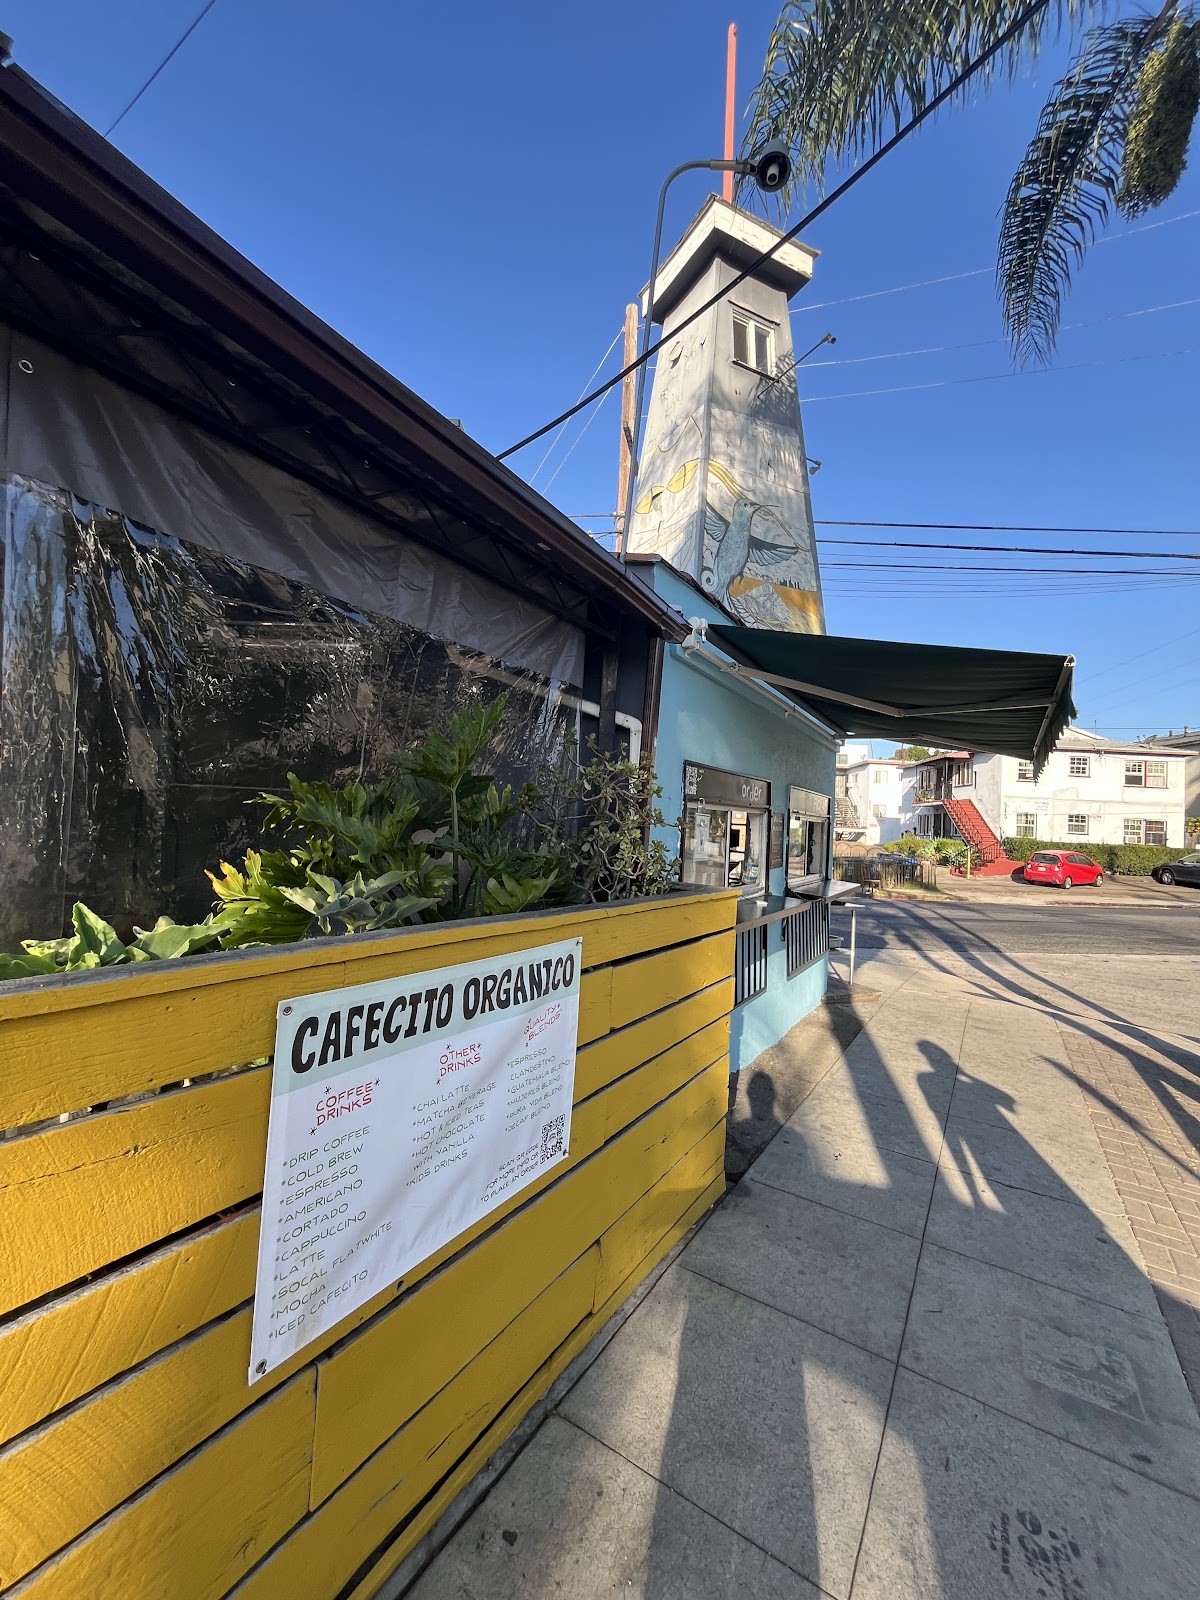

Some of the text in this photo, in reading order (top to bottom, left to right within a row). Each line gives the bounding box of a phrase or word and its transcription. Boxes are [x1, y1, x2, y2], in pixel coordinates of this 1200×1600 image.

[741, 784, 762, 802] order
[291, 954, 575, 1074] CAFECITO ORGANICO
[523, 1004, 557, 1035] QUALITY
[528, 1012, 561, 1041] BLENDS
[439, 1043, 476, 1065] OTHER
[440, 1053, 482, 1077] DRINKS
[510, 1047, 547, 1068] ESPRESSO
[510, 1055, 556, 1081] CLANDESTINO
[510, 1059, 570, 1094] GUATEMALA BLEND
[541, 1075, 561, 1091] BLEND
[316, 1082, 373, 1112] COFFEE
[317, 1093, 372, 1126] DRINKS
[417, 1084, 470, 1112] CHAI LATTE
[417, 1081, 497, 1128] MATCHA BEVERAGE
[509, 1105, 526, 1120] PURA
[543, 1084, 564, 1099] BLEND
[417, 1099, 485, 1144] HOT & ICED TEAS
[507, 1102, 551, 1133] DECAF BLEND
[289, 1126, 370, 1168] DRIP COFFEE
[413, 1133, 475, 1172] WITH VANILLA
[415, 1113, 486, 1159] HOT CHOCOLATE
[287, 1143, 364, 1187] COLD BREW
[409, 1148, 469, 1188] KIDS DRINKS
[480, 1194, 489, 1204] TO
[490, 1181, 510, 1198] PLACE
[520, 1161, 539, 1177] ORDER
[485, 1178, 498, 1191] FOR
[499, 1167, 516, 1181] MORE
[499, 1158, 515, 1172] SCAN
[284, 1179, 363, 1224] AMERICANO
[285, 1164, 358, 1206] ESPRESSO
[281, 1210, 367, 1262] CAPPUCCINO
[282, 1203, 349, 1243] CORTADO
[279, 1249, 325, 1281] LATTE
[278, 1267, 328, 1299] SOCAL
[275, 1269, 369, 1338] ICED CAFECITO
[276, 1284, 326, 1319] MOCHA
